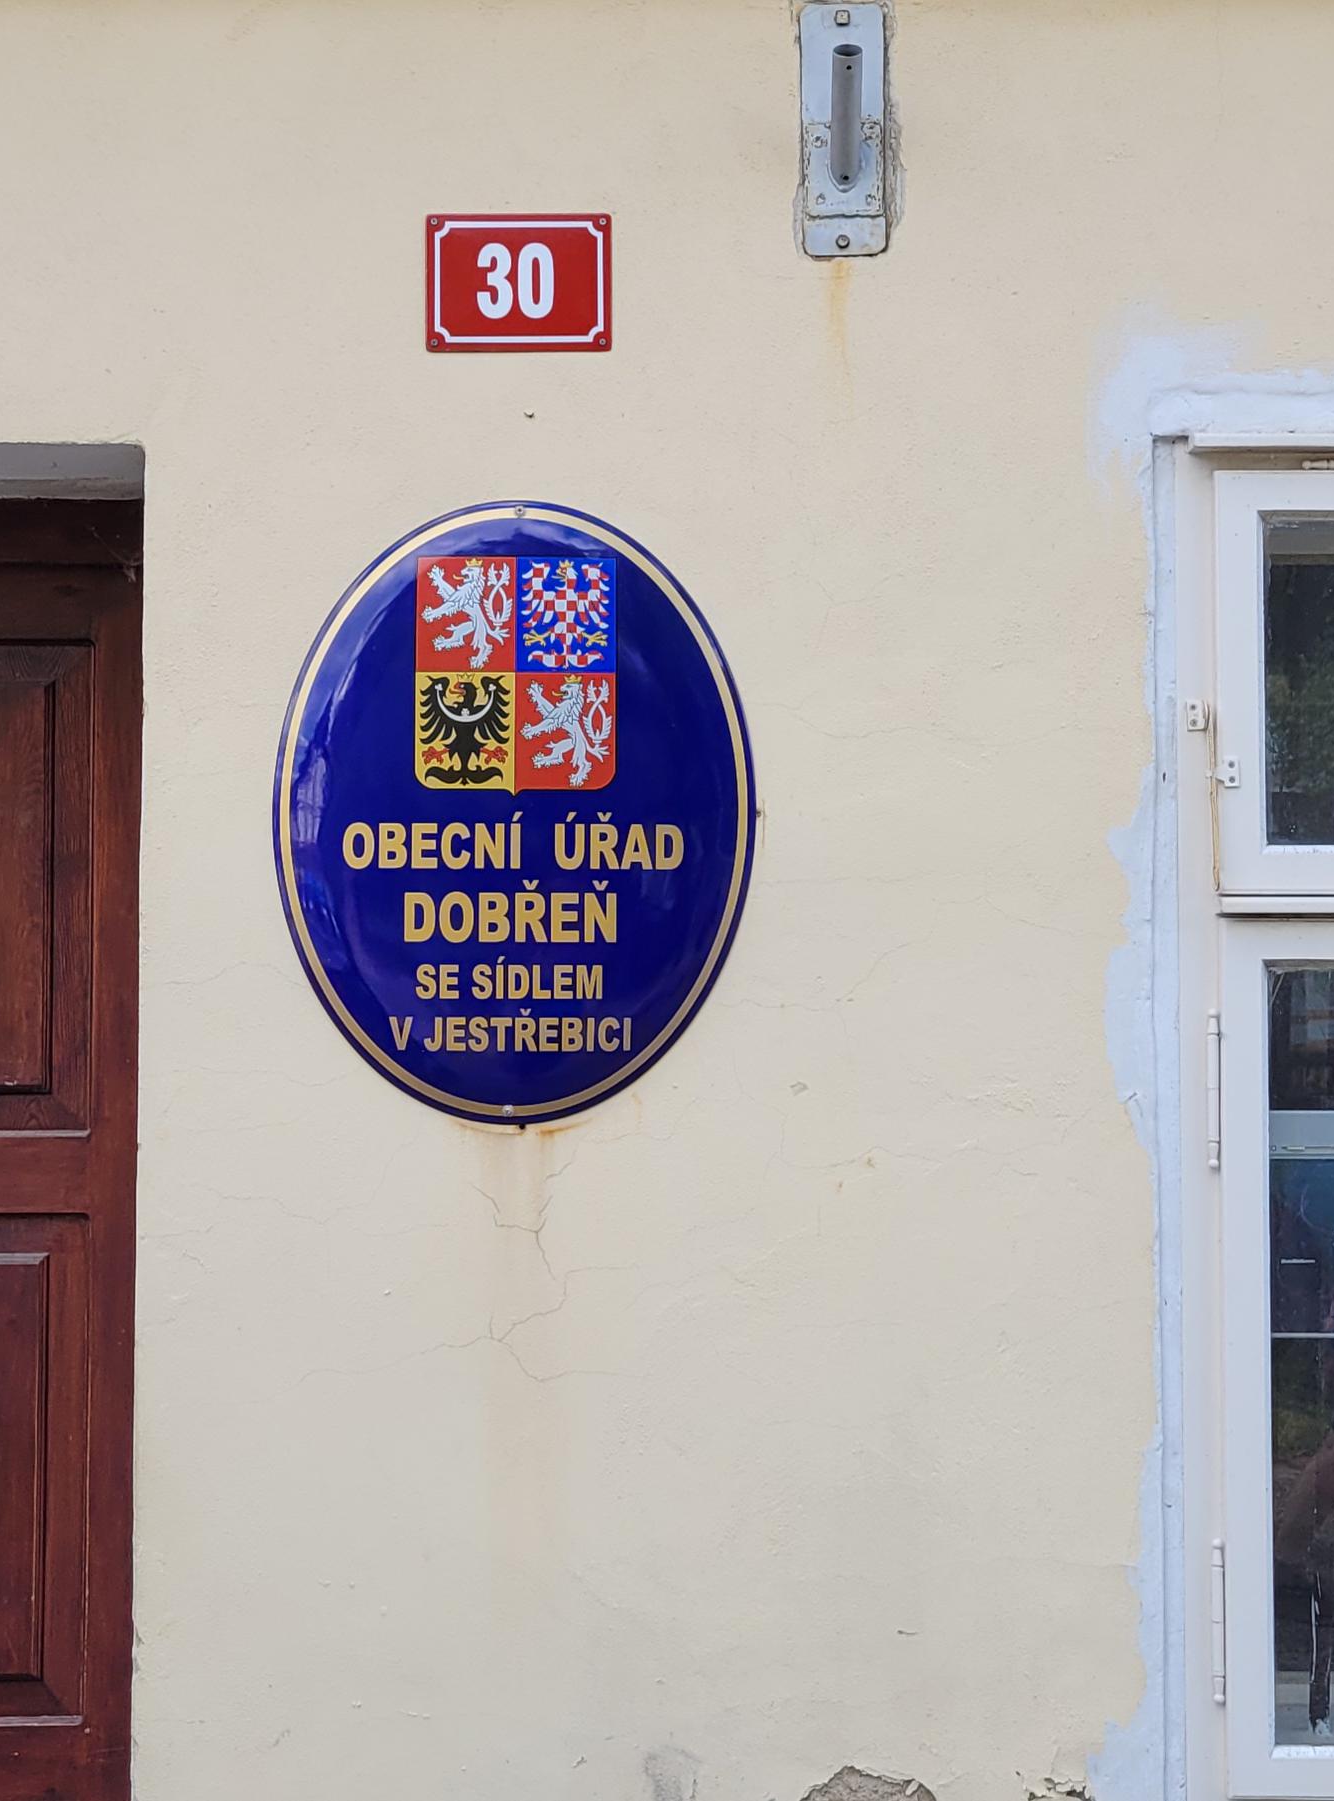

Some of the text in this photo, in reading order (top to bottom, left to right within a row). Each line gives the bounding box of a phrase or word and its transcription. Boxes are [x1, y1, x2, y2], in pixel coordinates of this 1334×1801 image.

[477, 242, 554, 319] 30
[342, 811, 685, 871] OBECNÍ ÚŘAD
[403, 880, 617, 944] DOBŘEŇ
[415, 956, 603, 1000] SE SÍDLEM
[389, 1009, 632, 1053] V JESTŘEBICI
